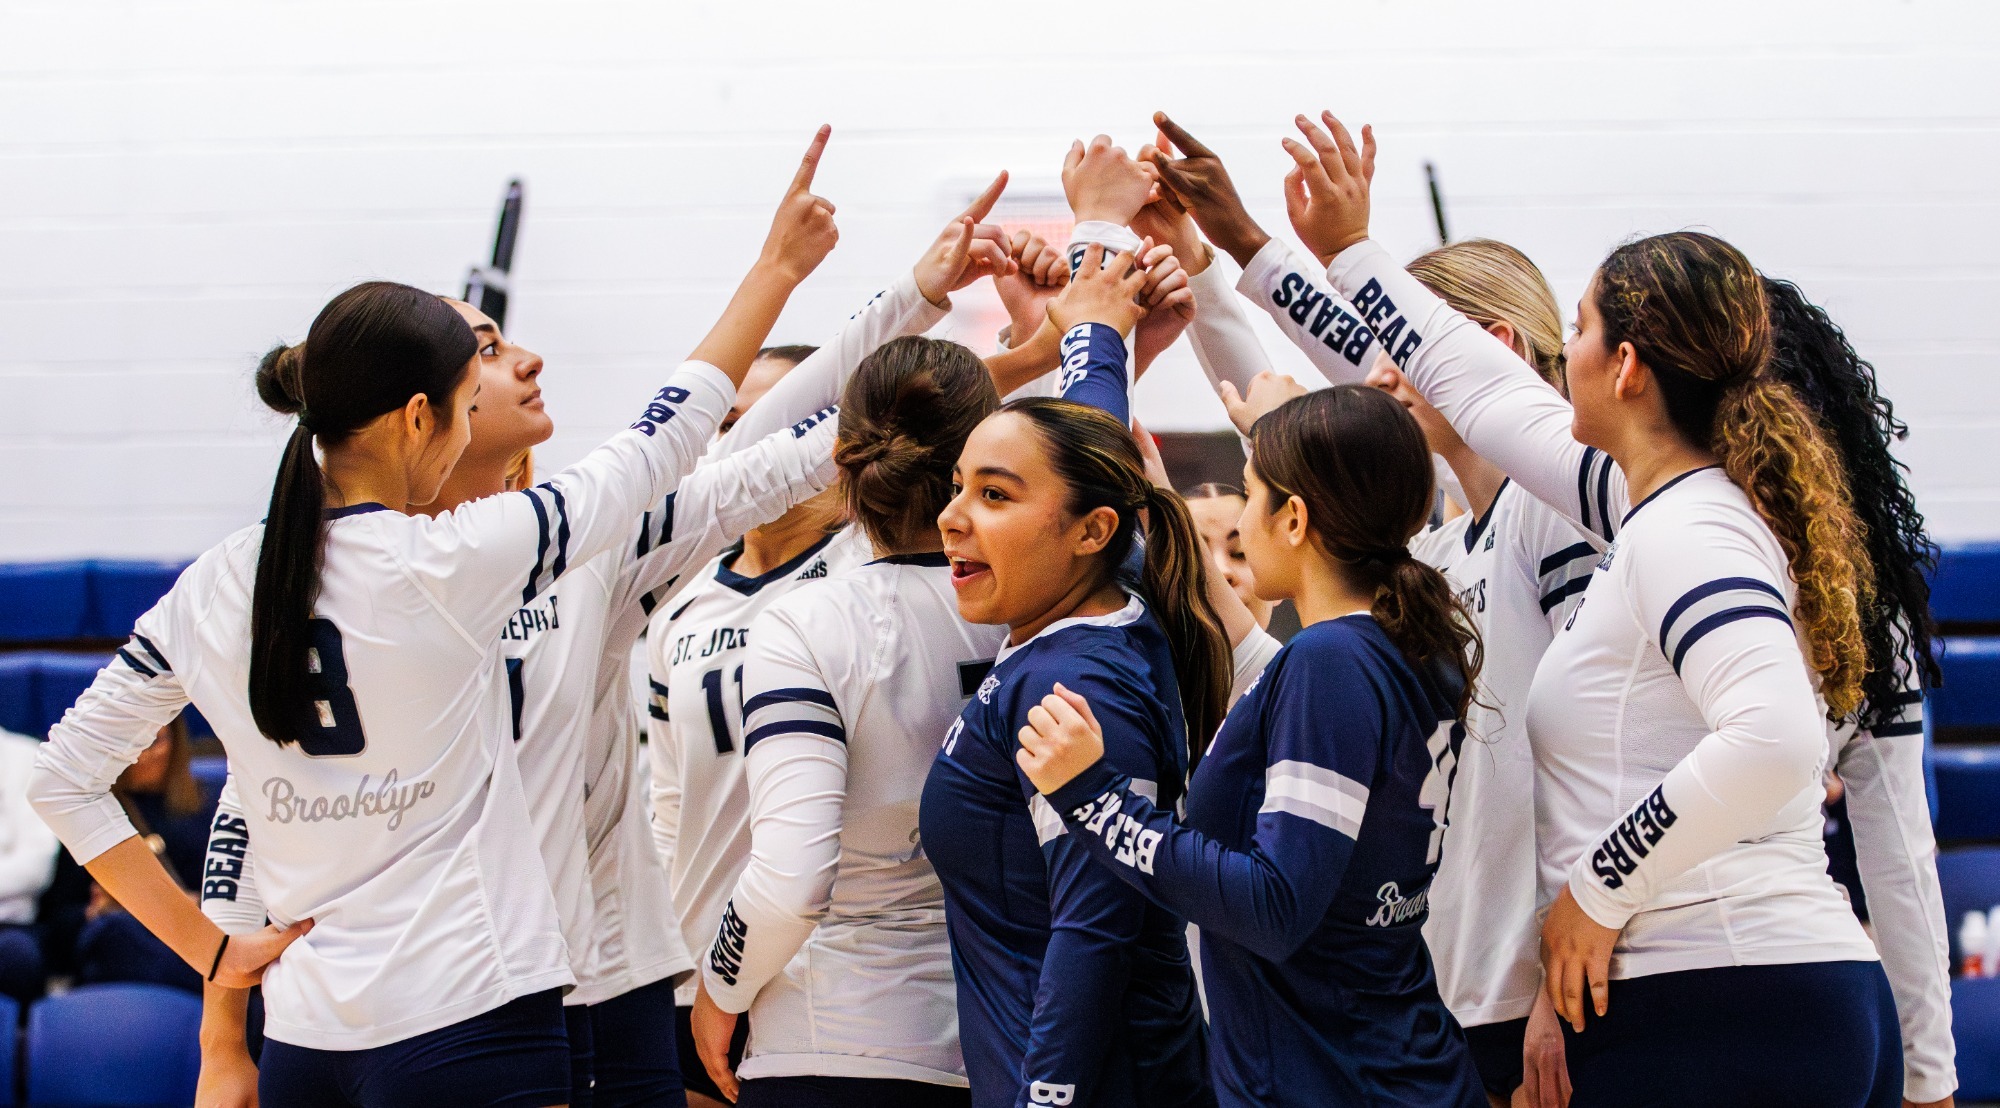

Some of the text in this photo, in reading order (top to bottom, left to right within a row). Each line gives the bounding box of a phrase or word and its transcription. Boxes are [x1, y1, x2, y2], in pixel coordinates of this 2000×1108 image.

[1272, 272, 1375, 367] BEARS
[673, 634, 697, 666] ST.
[262, 768, 436, 832] Brooklyn
[1592, 782, 1678, 890] BEARS
[203, 813, 250, 902] BEARS
[711, 896, 748, 987] BEARS
